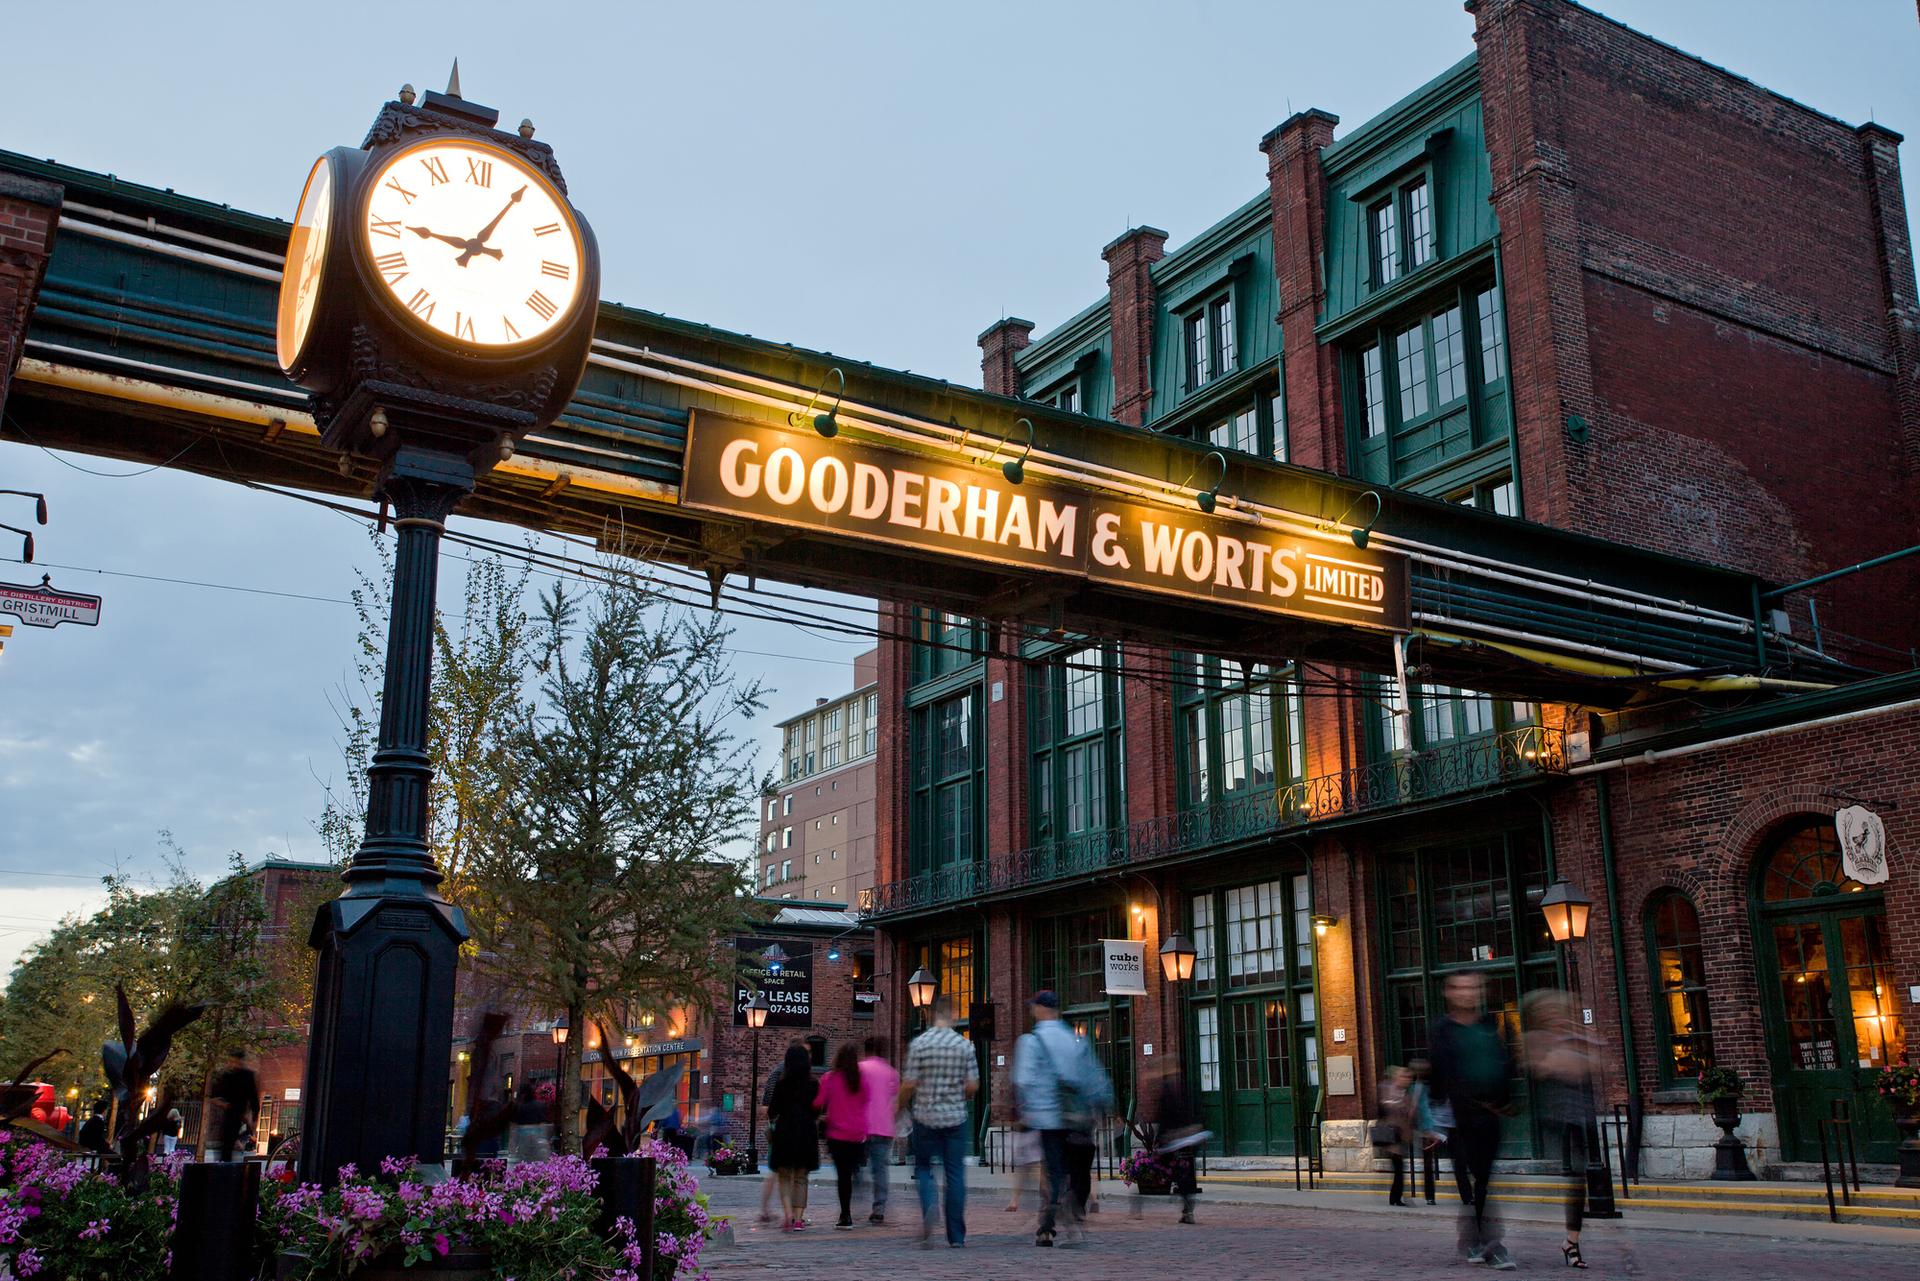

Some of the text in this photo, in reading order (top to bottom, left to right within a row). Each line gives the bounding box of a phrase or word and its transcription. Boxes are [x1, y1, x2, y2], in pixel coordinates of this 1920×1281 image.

[719, 438, 1385, 602] GOODERHAM & WORTS LIMITED
[10, 591, 55, 602] DISTILLERY
[57, 598, 94, 608] DISTRICT
[3, 600, 79, 619] GRISTMILL
[30, 616, 51, 624] LANE
[1110, 953, 1139, 962] cube
[1110, 962, 1139, 971] works
[780, 969, 807, 978] RETAIL
[769, 990, 809, 1003] LEASE
[770, 1004, 810, 1015] 07-3450
[663, 1042, 685, 1051] CENTRE
